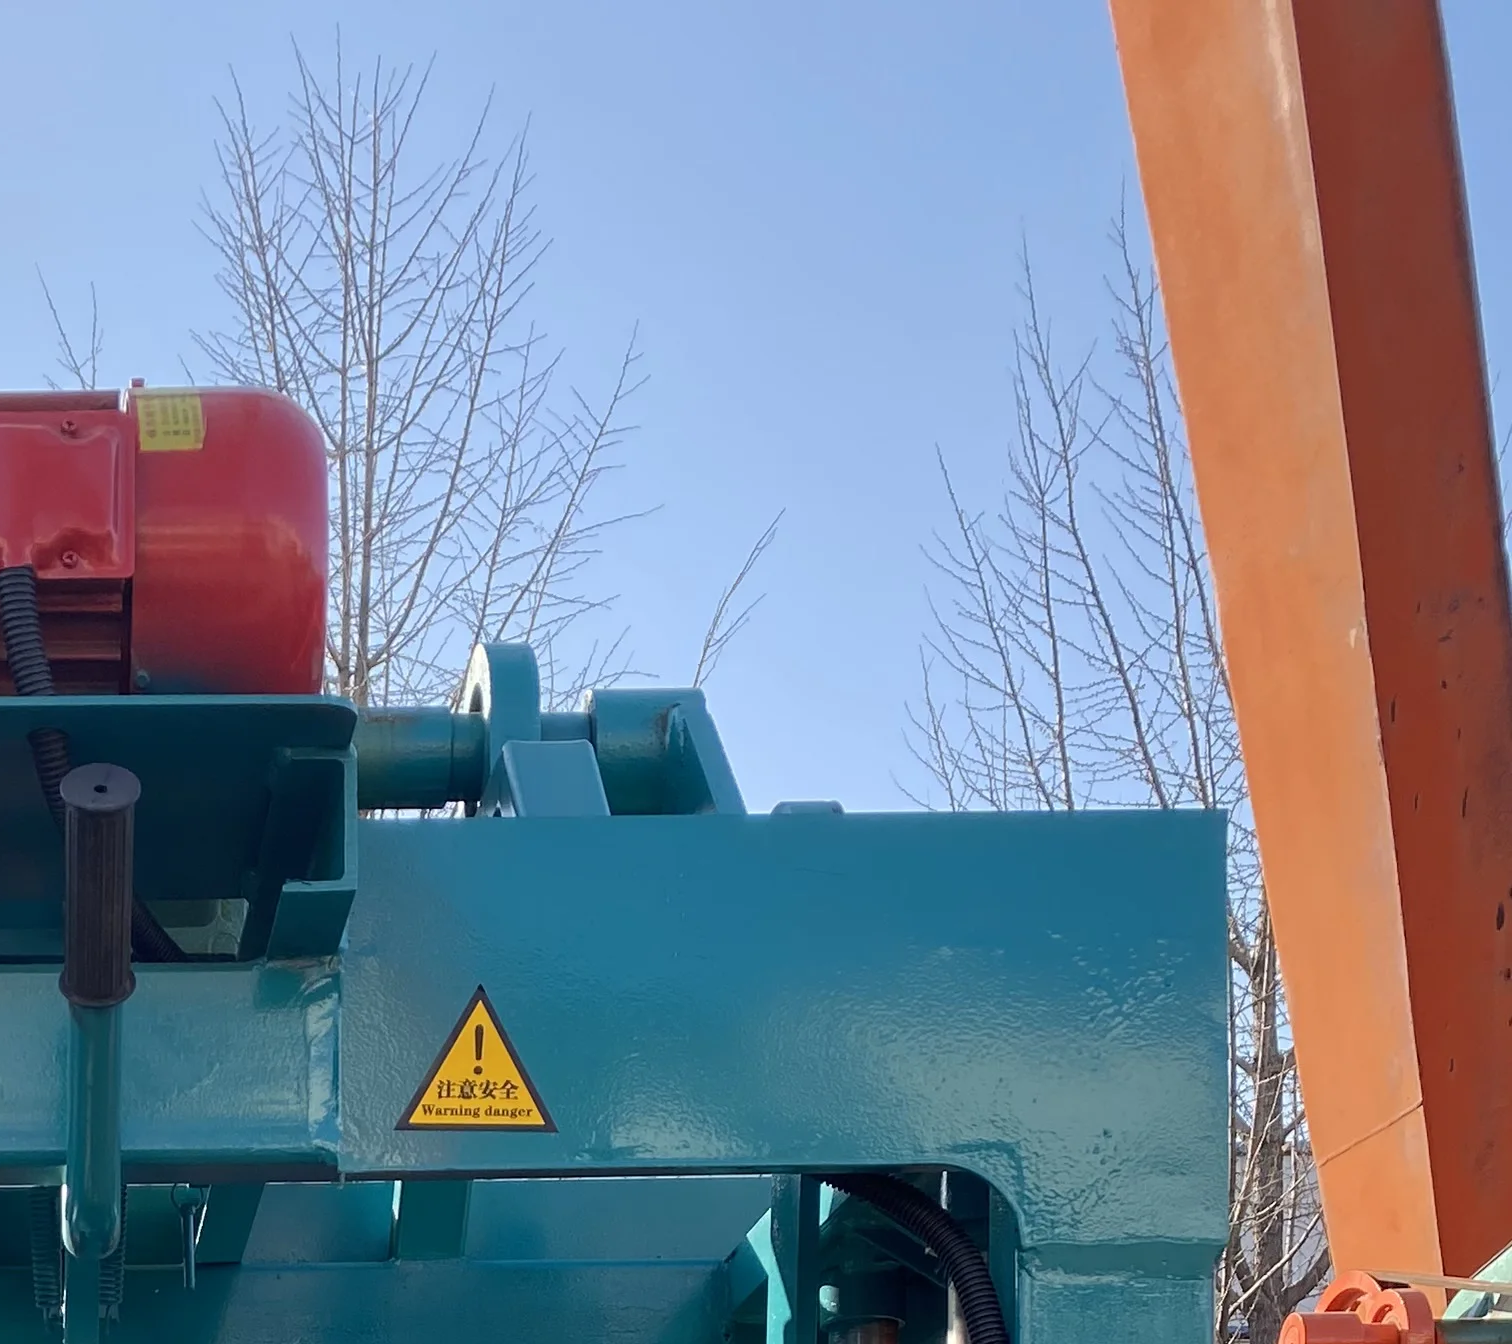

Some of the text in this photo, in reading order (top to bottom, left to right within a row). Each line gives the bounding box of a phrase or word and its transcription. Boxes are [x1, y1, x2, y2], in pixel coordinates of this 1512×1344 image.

[437, 1079, 519, 1100] 注意安全
[421, 1104, 533, 1118] Warning danger
